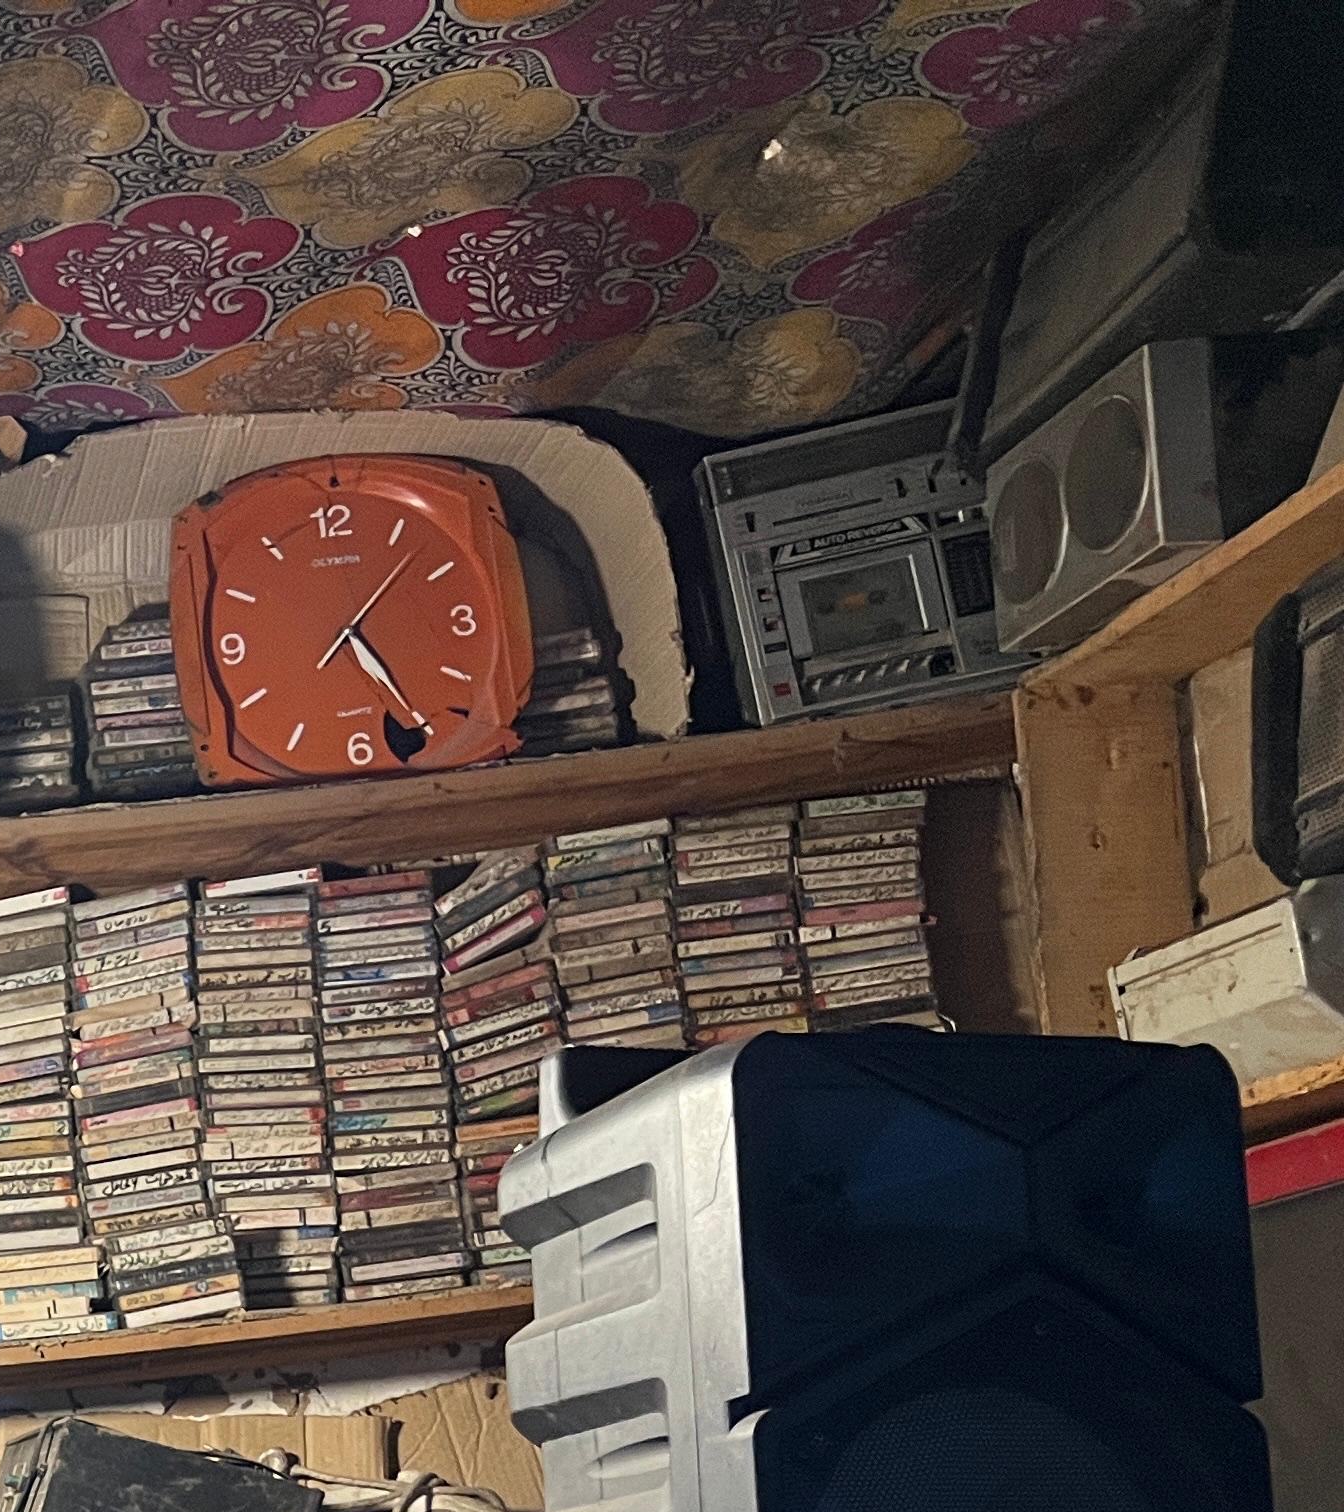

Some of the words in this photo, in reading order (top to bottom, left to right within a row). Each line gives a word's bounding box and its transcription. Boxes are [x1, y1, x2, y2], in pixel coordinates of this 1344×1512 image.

[310, 504, 353, 539] 12
[450, 604, 477, 636] 3
[219, 633, 246, 665] 9
[346, 732, 374, 765] 6
